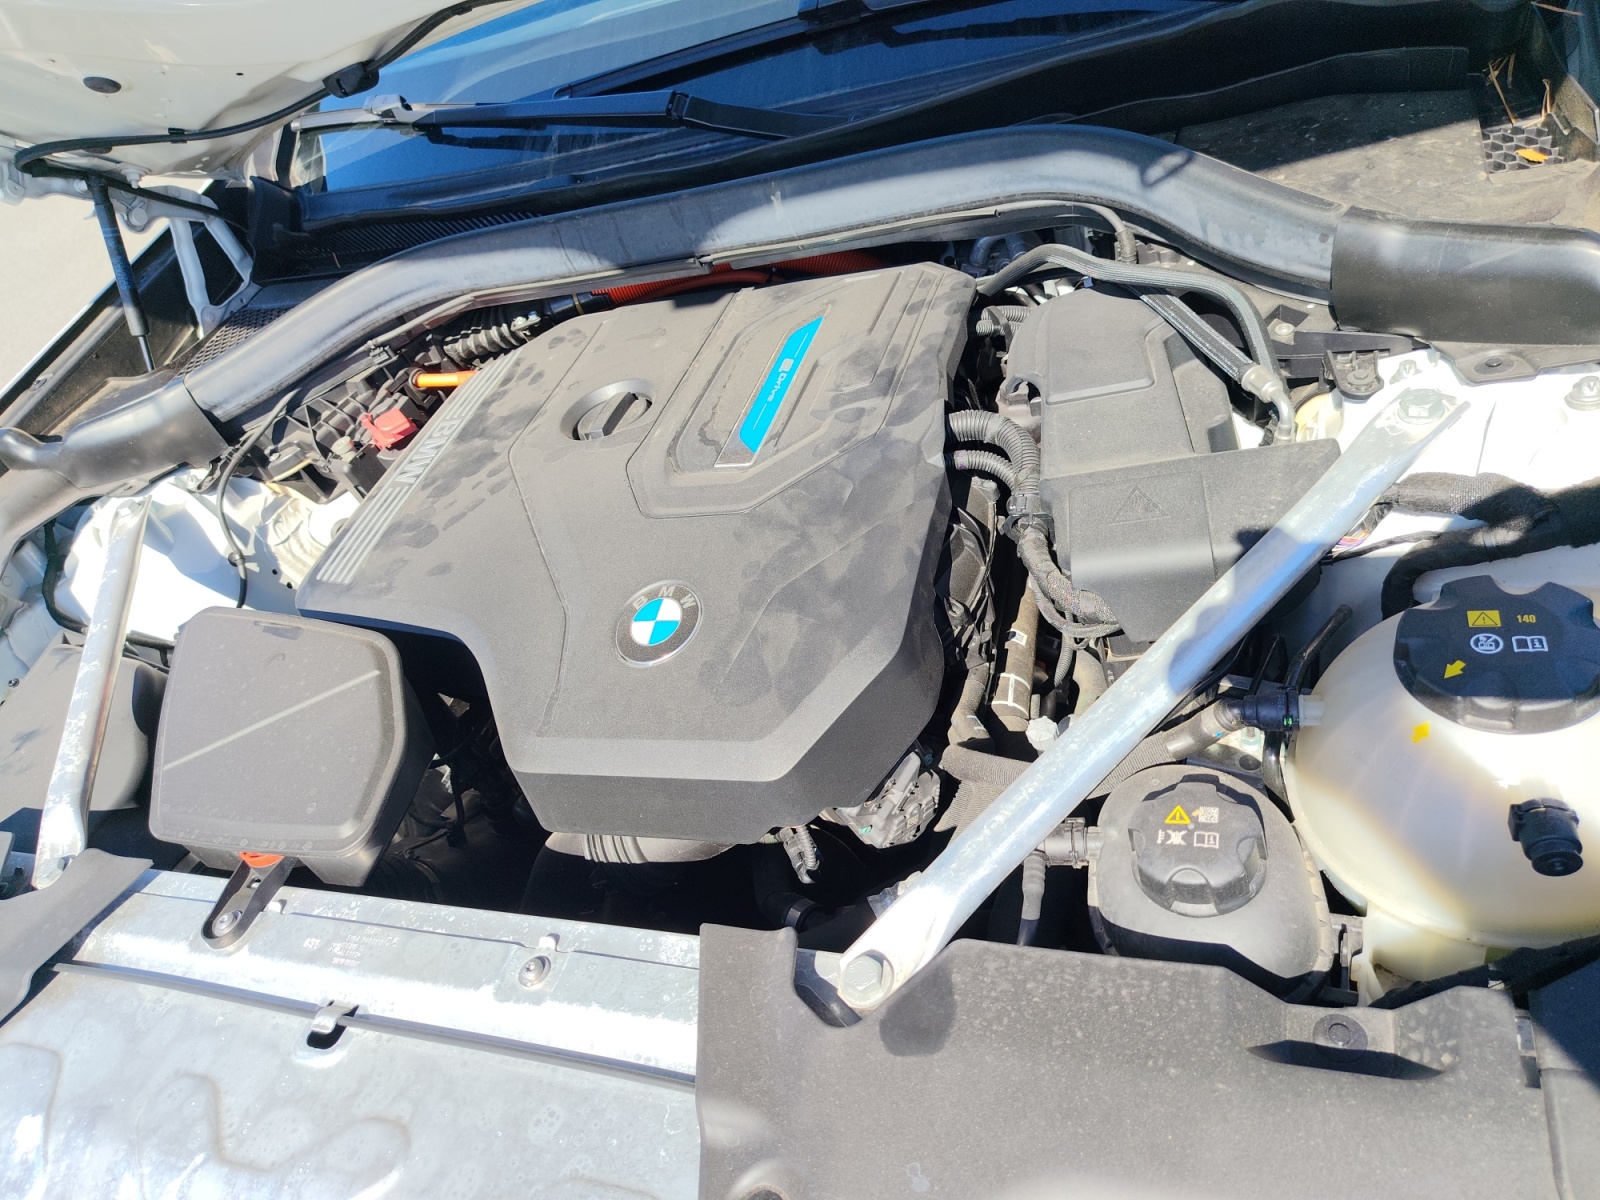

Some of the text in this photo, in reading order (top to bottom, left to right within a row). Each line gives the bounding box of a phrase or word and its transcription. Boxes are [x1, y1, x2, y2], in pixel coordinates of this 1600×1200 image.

[394, 420, 462, 483] BMW
[633, 585, 697, 609] BMW
[1516, 614, 1537, 624] 140
